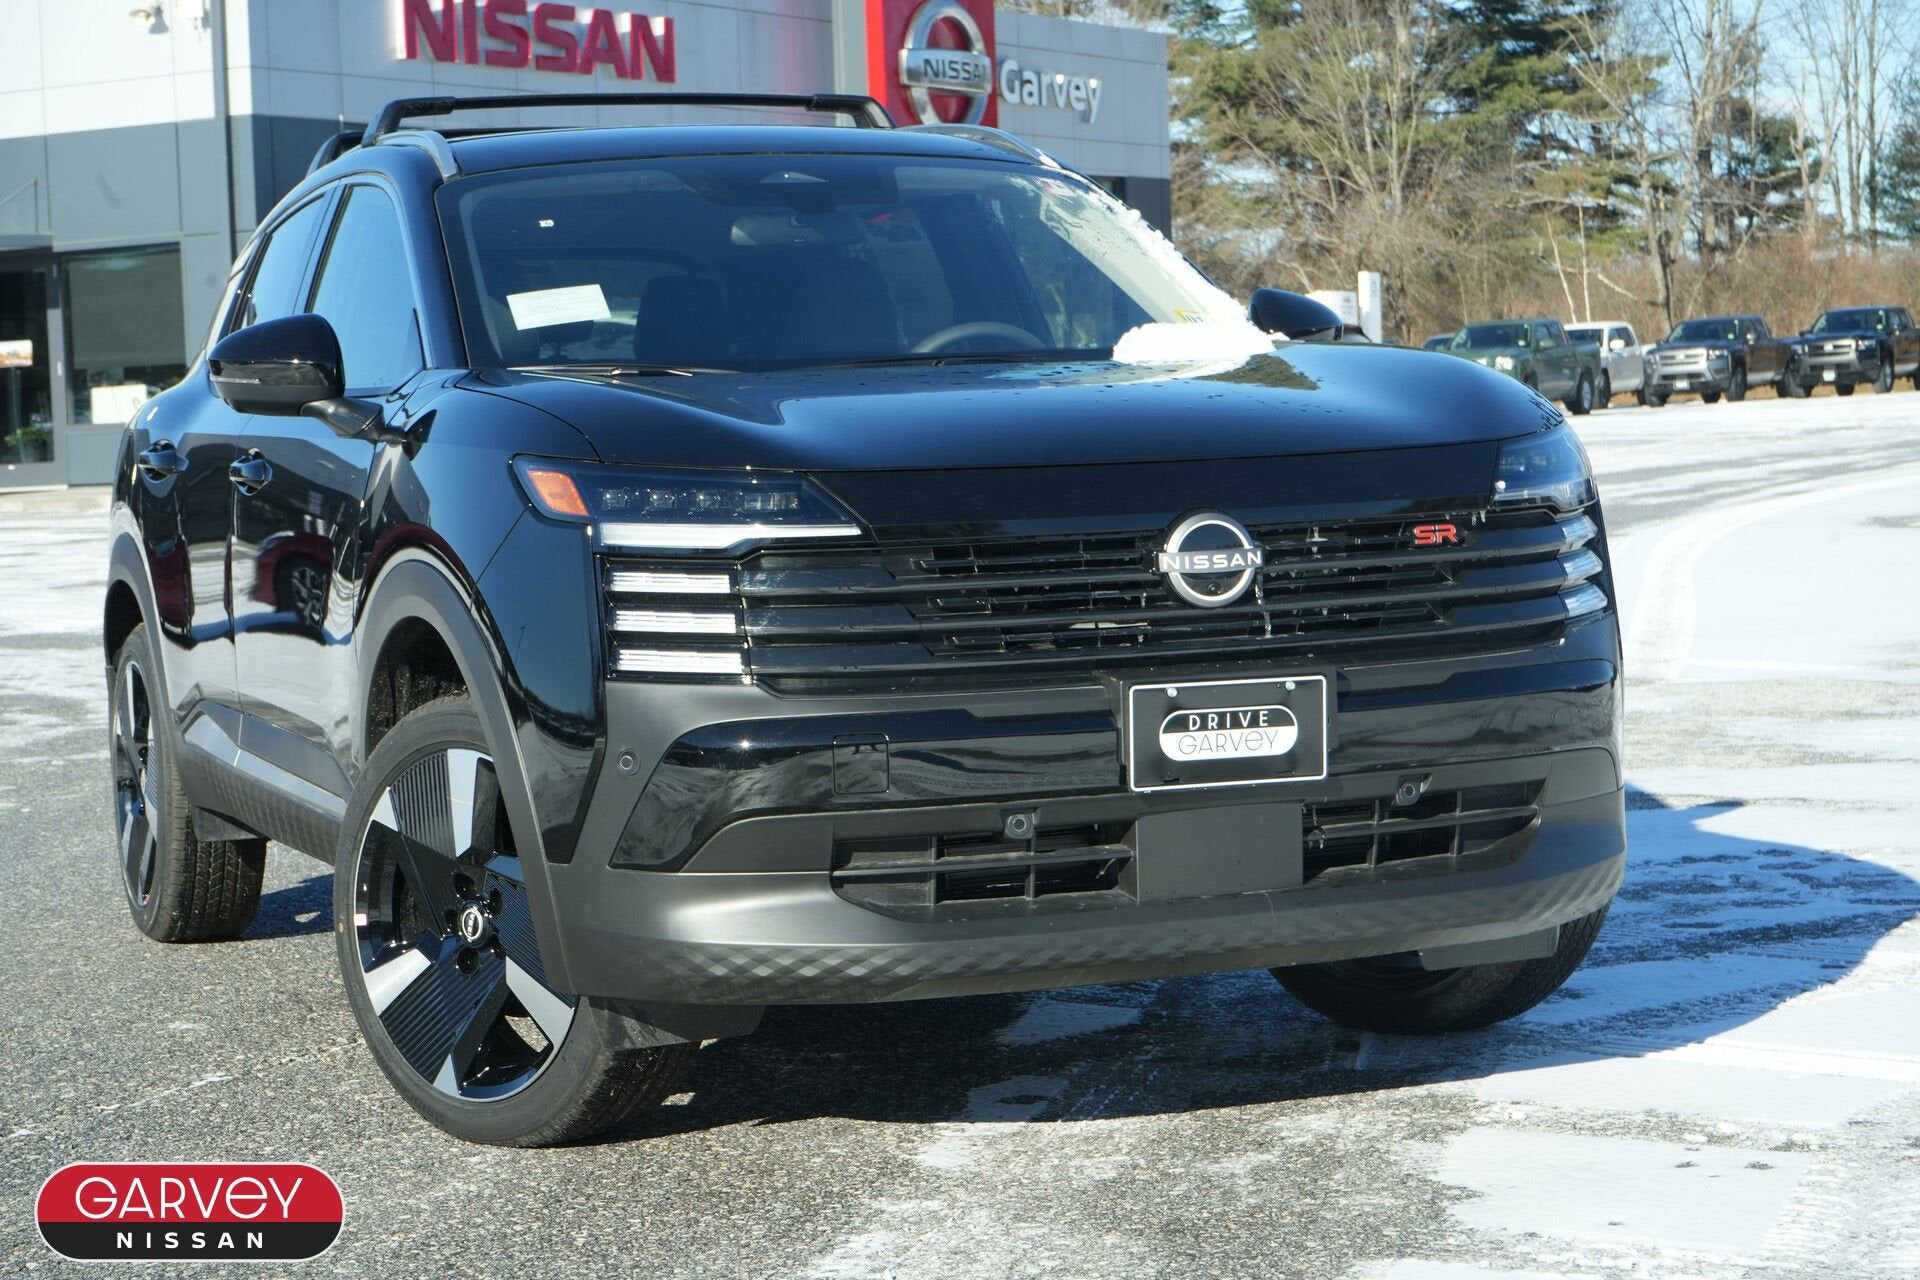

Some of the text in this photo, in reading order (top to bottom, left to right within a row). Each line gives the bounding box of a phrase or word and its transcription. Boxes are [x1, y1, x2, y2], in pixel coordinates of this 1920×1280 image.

[403, 0, 676, 83] NISSAN
[1000, 59, 1101, 124] Garvey
[1413, 523, 1458, 545] SR
[1161, 551, 1261, 572] NISSAN
[1189, 711, 1269, 731] DRIVE
